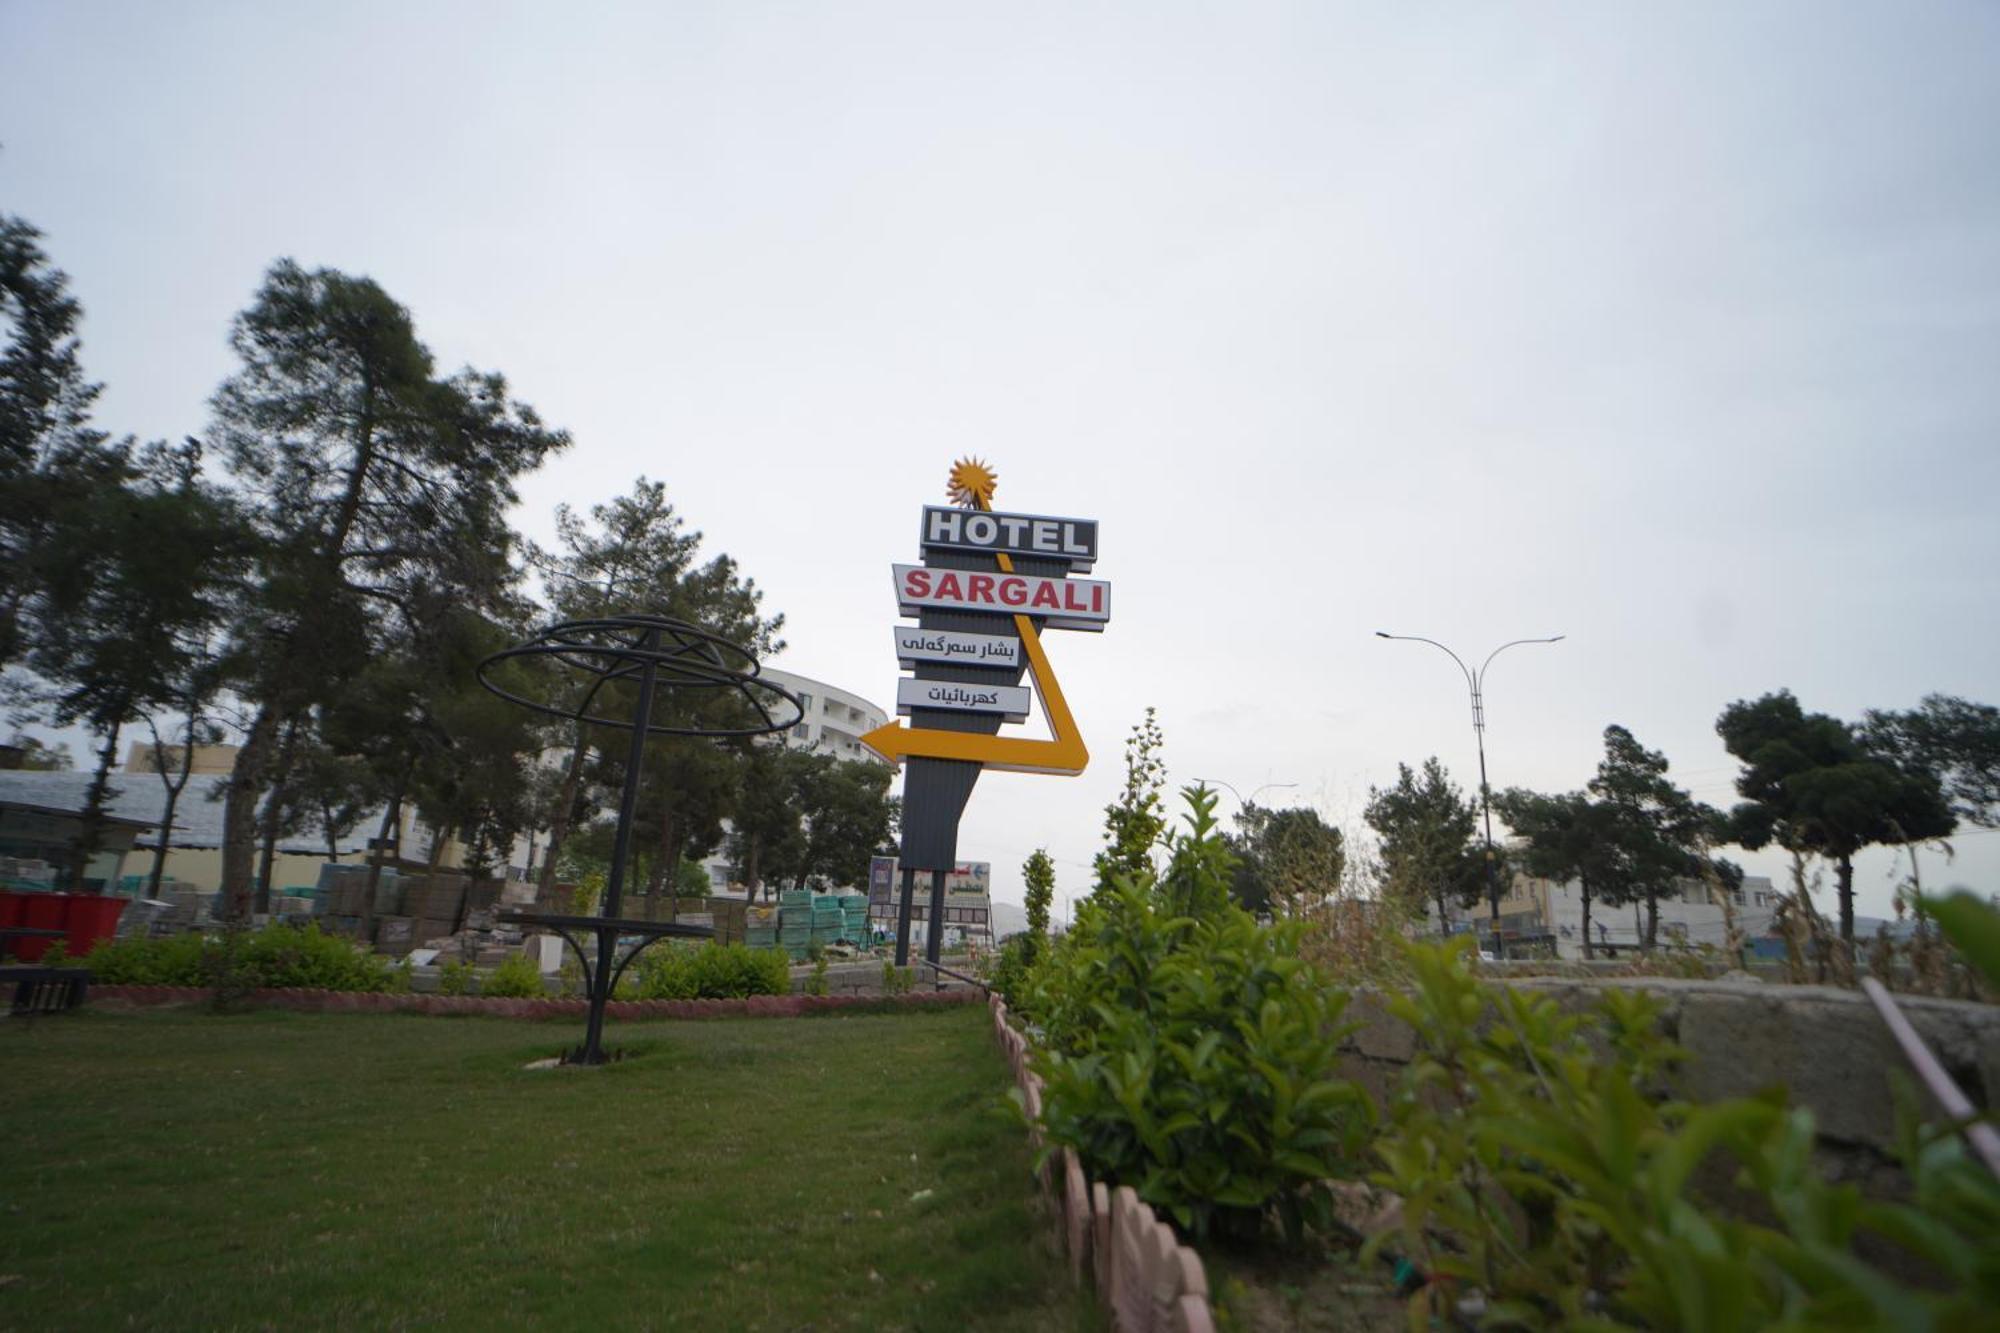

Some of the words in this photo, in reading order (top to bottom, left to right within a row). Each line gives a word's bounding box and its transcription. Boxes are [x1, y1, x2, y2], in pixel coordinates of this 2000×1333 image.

[929, 511, 1089, 553] HOTEL
[905, 570, 1103, 613] SARGALI
[979, 641, 1014, 660] بشار
